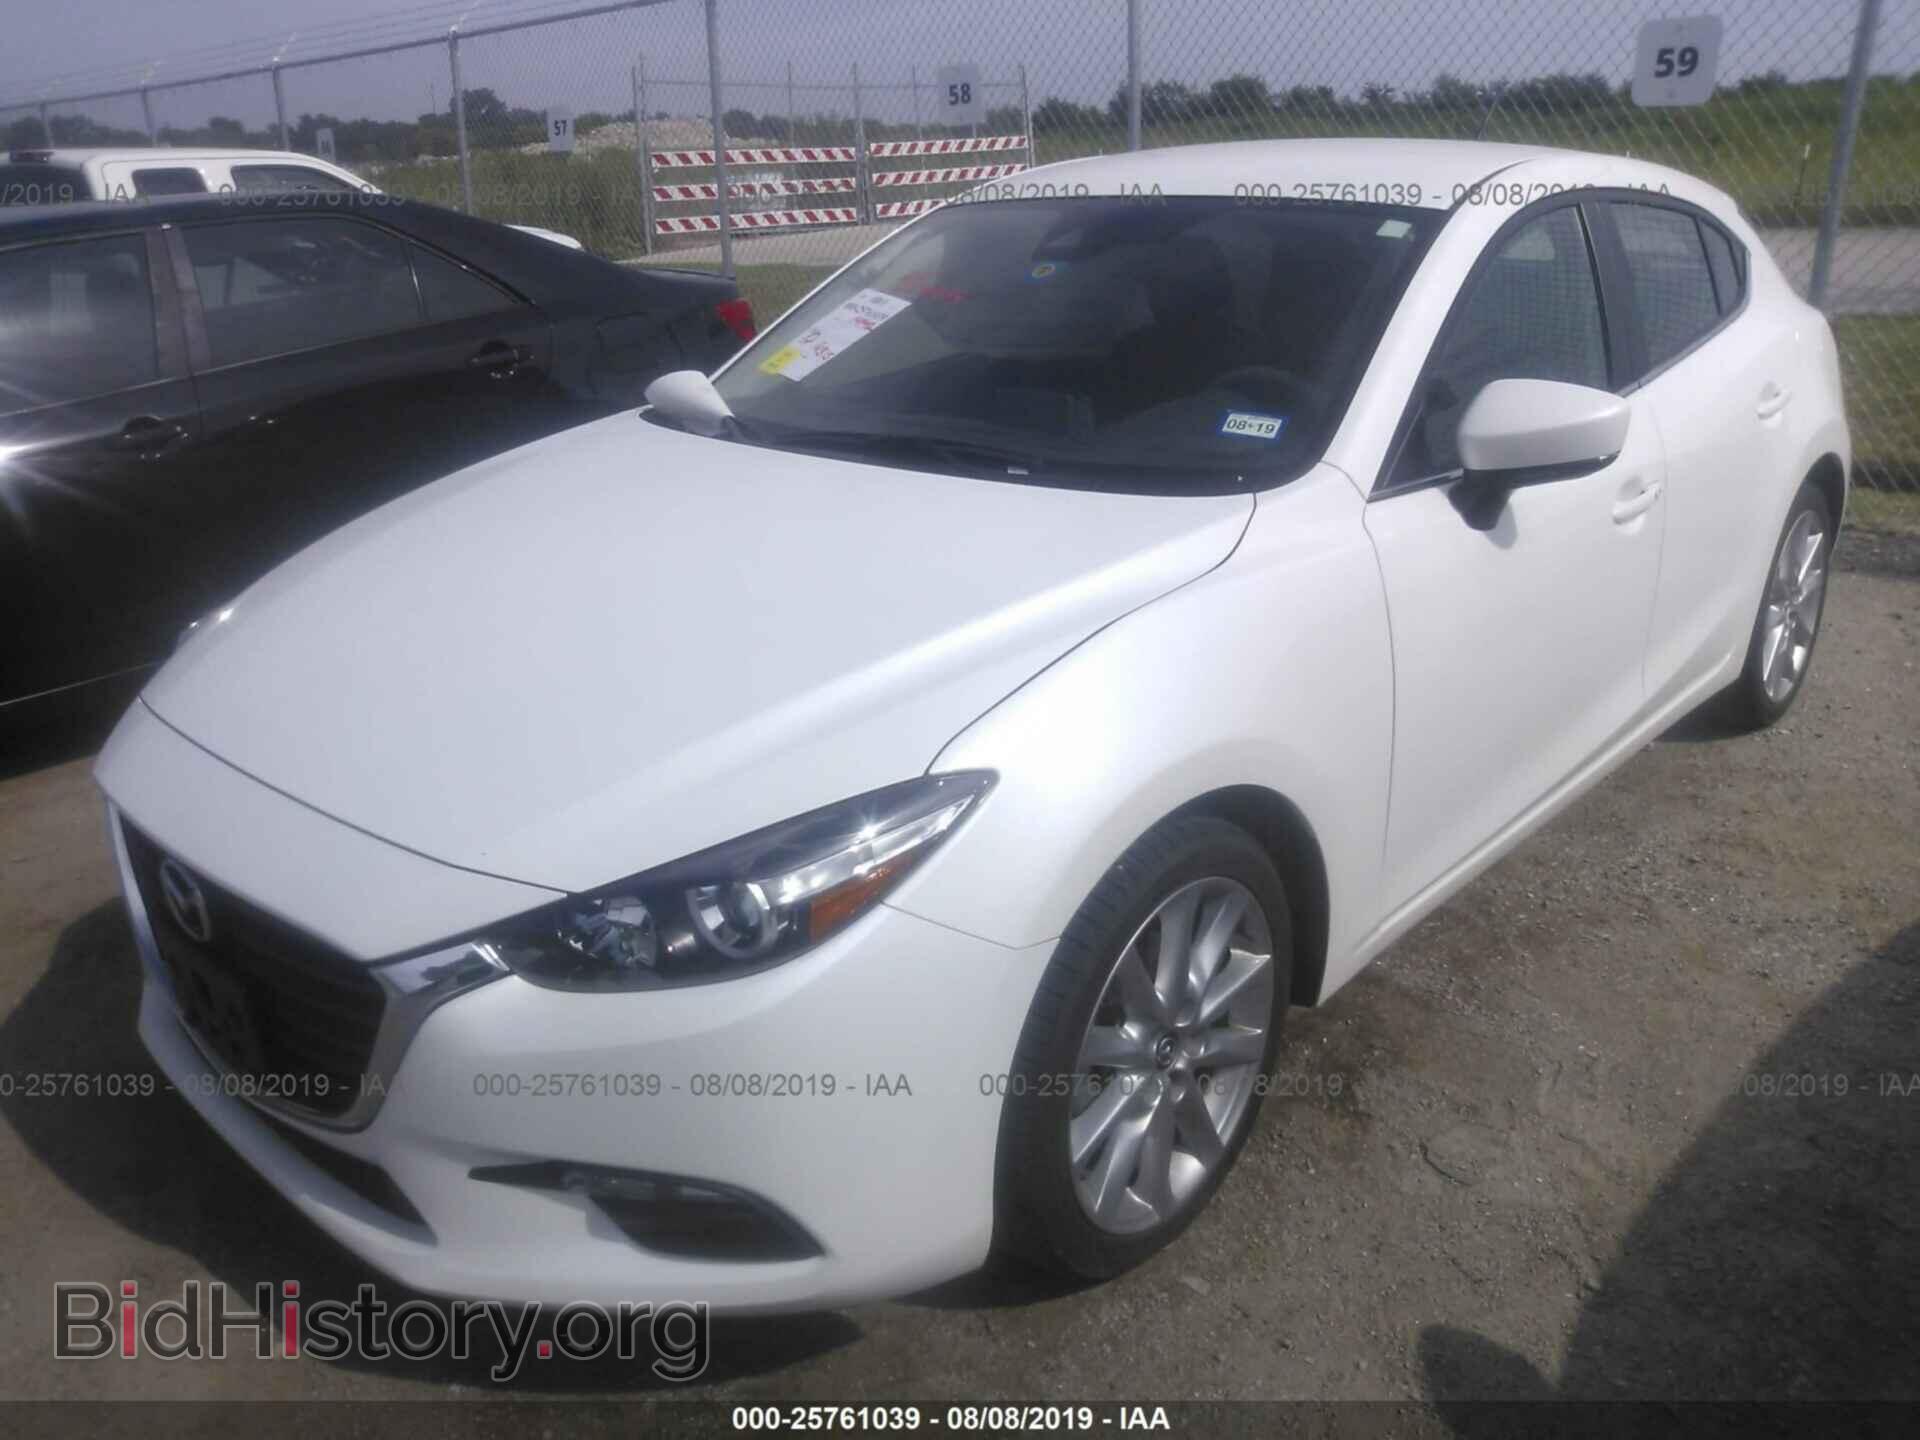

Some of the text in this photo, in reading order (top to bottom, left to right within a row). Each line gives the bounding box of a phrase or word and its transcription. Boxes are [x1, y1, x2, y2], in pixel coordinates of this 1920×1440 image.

[1654, 46, 1699, 78] 59
[948, 82, 971, 106] 58
[553, 119, 568, 137] 57
